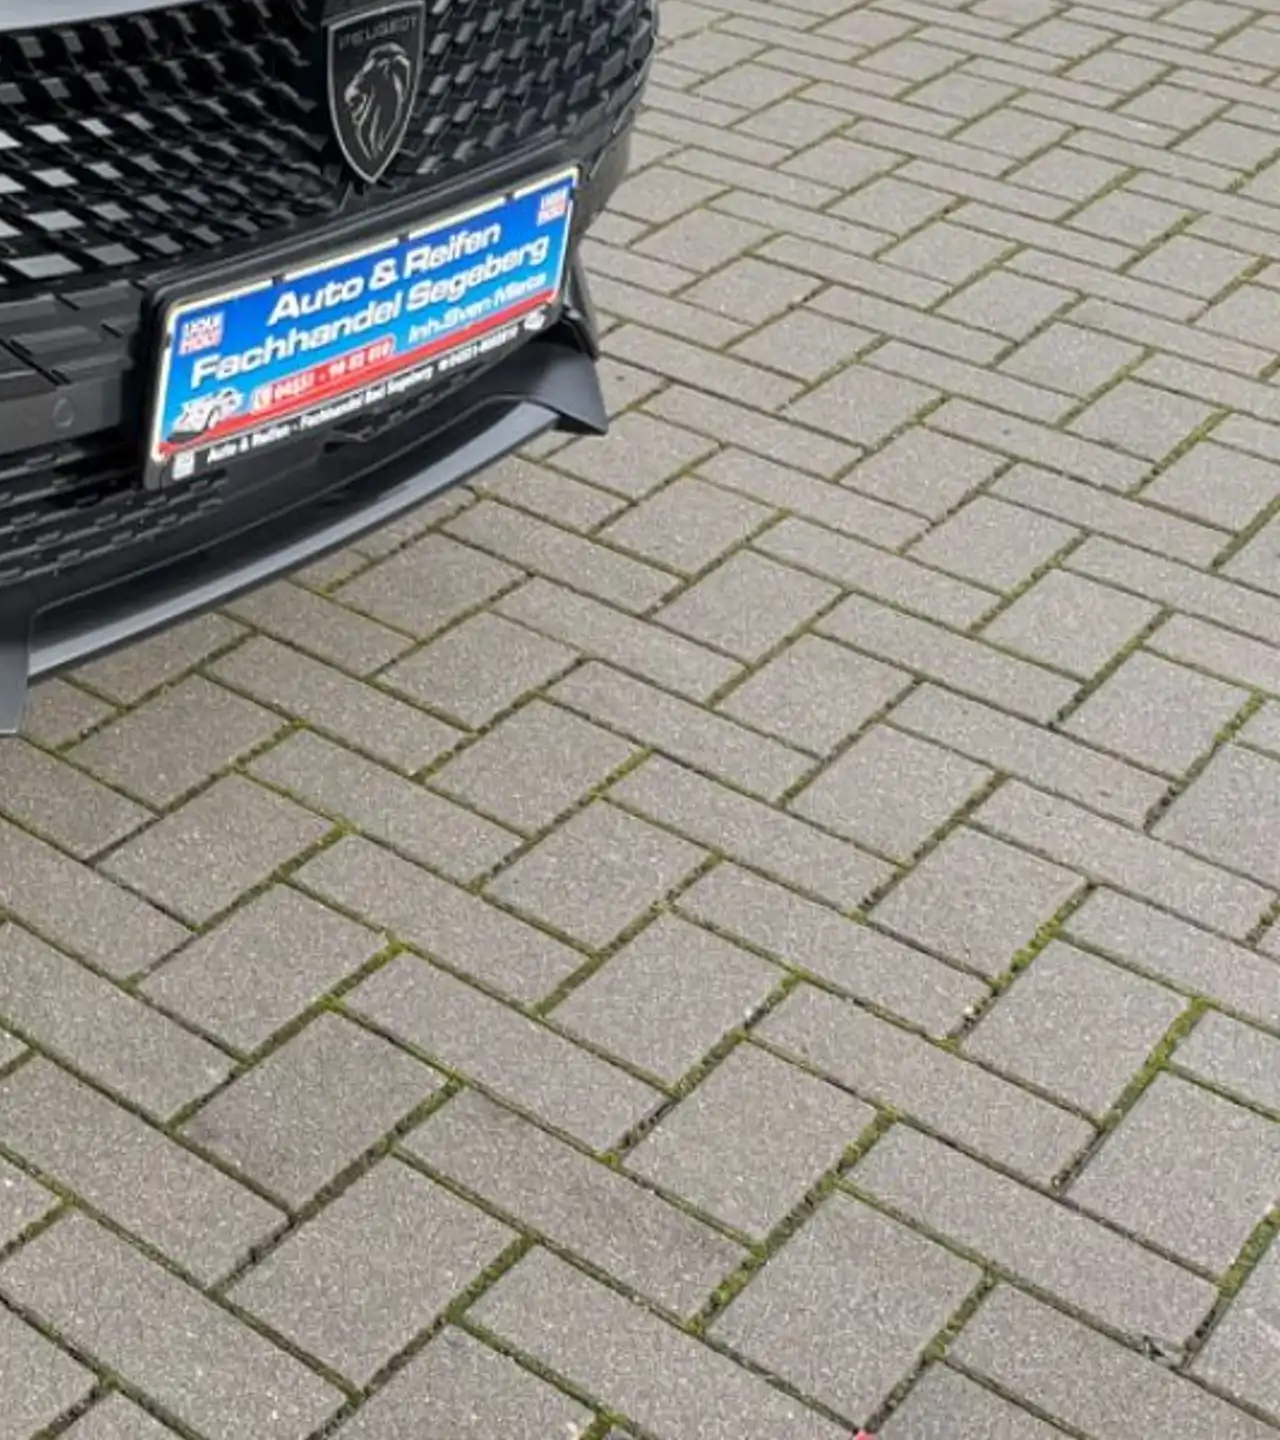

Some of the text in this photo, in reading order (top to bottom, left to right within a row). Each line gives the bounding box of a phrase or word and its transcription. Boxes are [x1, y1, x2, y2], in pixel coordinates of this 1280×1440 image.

[190, 290, 404, 390] Fachhandel
[406, 236, 550, 312] Segeberg
[266, 222, 502, 327] Auto & Reifen
